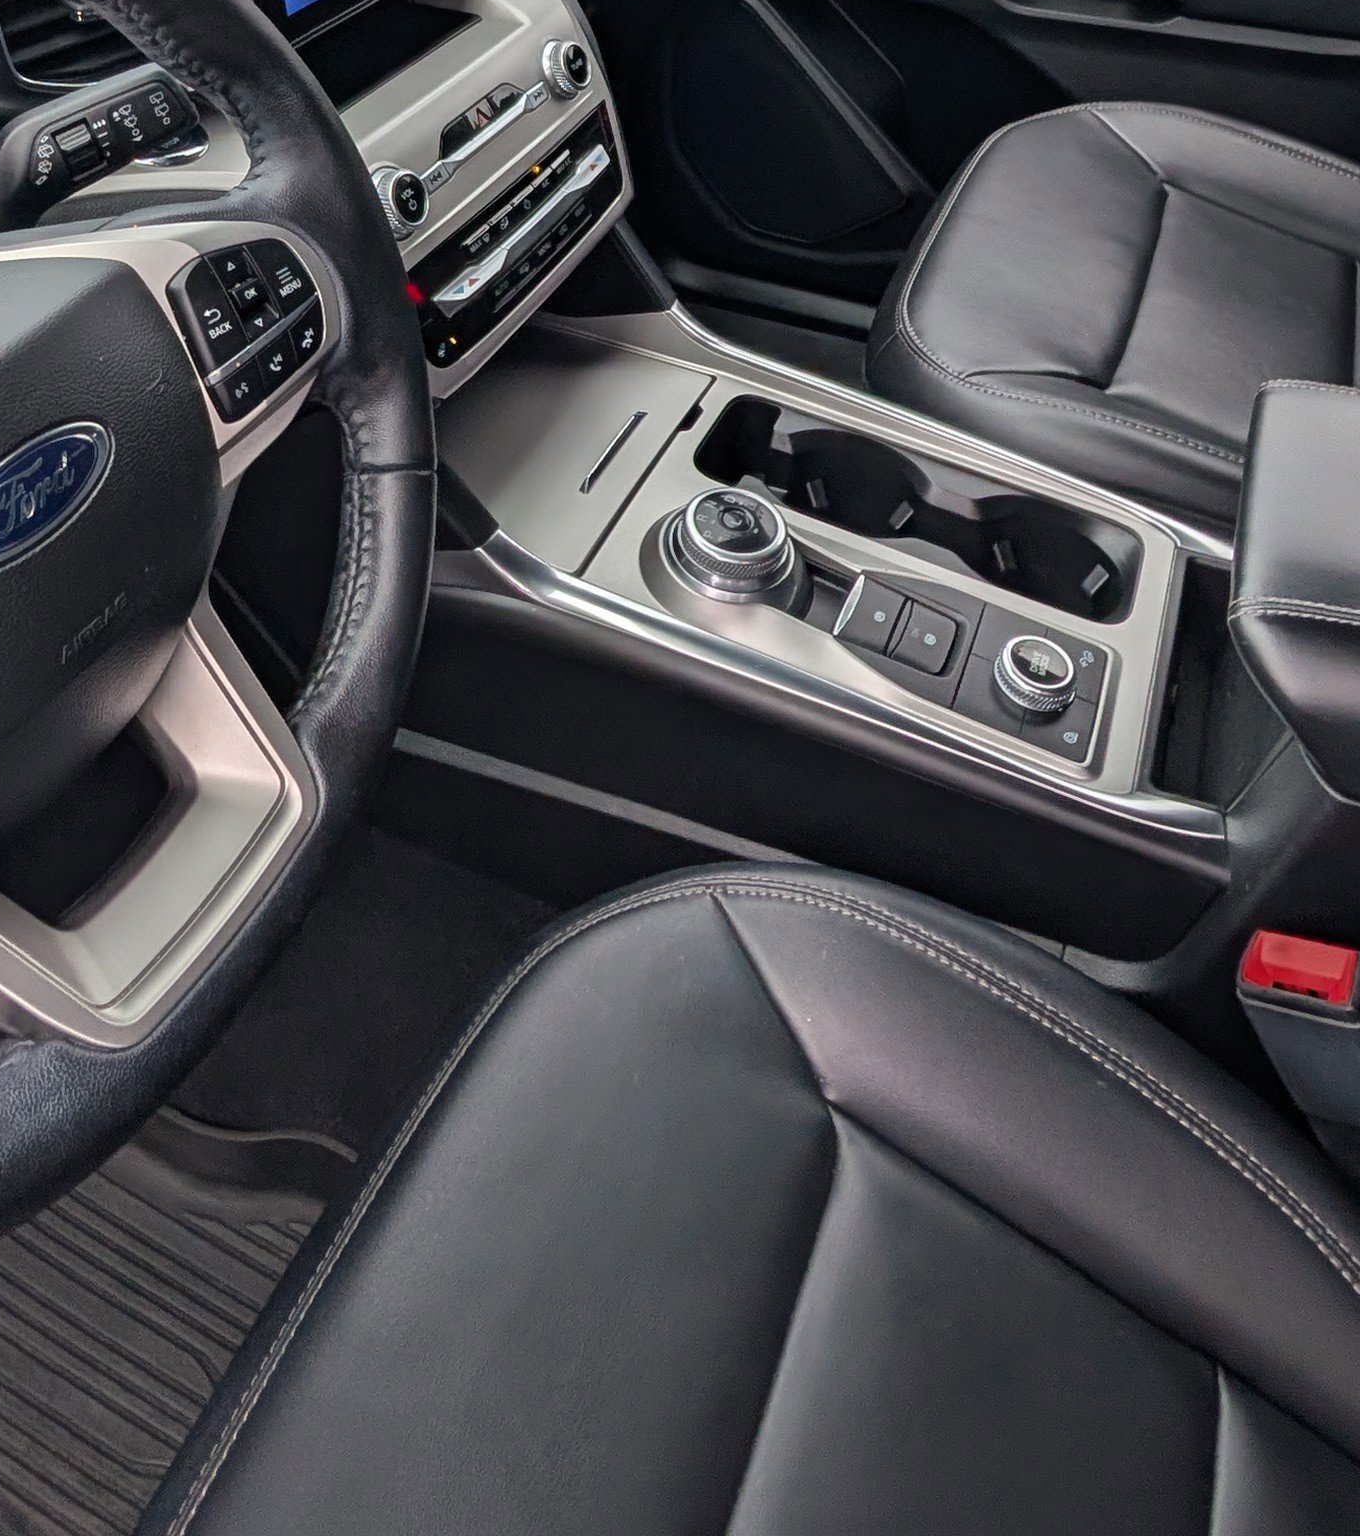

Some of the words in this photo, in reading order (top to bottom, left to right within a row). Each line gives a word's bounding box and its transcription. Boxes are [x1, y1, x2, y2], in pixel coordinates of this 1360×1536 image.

[400, 186, 415, 201] VOL
[243, 287, 259, 301] OK
[279, 277, 302, 298] MENU
[207, 321, 234, 340] BACK
